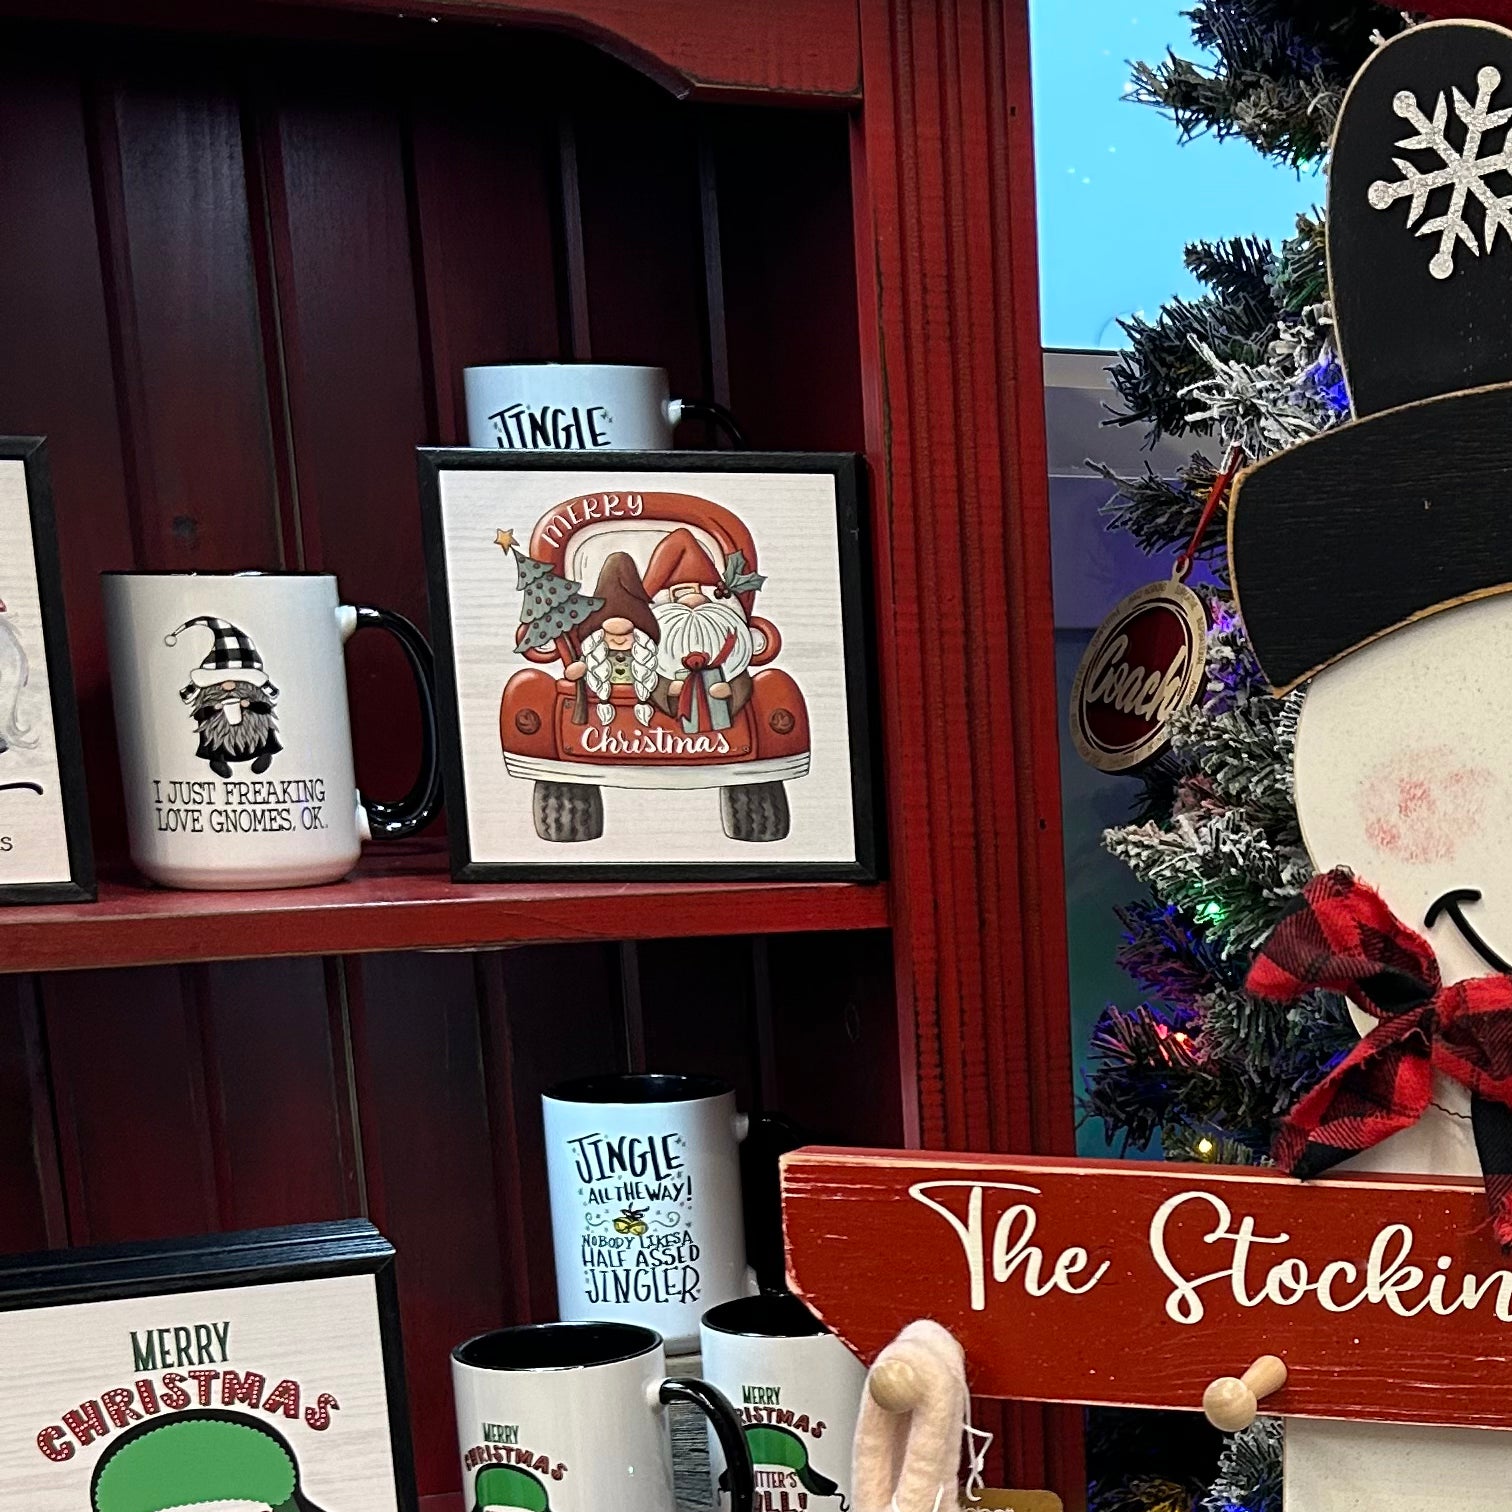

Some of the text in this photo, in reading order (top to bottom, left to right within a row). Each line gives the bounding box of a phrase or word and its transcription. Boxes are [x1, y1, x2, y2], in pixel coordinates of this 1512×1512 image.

[541, 493, 644, 548] MERRY
[1085, 634, 1187, 722] Coach
[580, 726, 731, 754] Christmas
[153, 778, 326, 805] I JUST FREAKING
[156, 808, 204, 833] LOVE
[567, 1133, 684, 1184] JINGLE
[588, 1175, 692, 1205] ALL THE WAY!
[581, 1244, 700, 1267] HALF ASSED
[582, 1230, 694, 1250] NOBODY LIKES A
[908, 1180, 1111, 1311] The
[585, 1264, 700, 1304] JINGLER
[129, 1321, 231, 1373] MERRY
[742, 1385, 781, 1406] MERRY
[36, 1369, 340, 1462] CHRISTMAS
[732, 1406, 827, 1439] RISTMAS
[482, 1422, 519, 1444] MERRY
[464, 1445, 568, 1481] CHRISTMAS
[754, 1471, 797, 1488] ITTER'S
